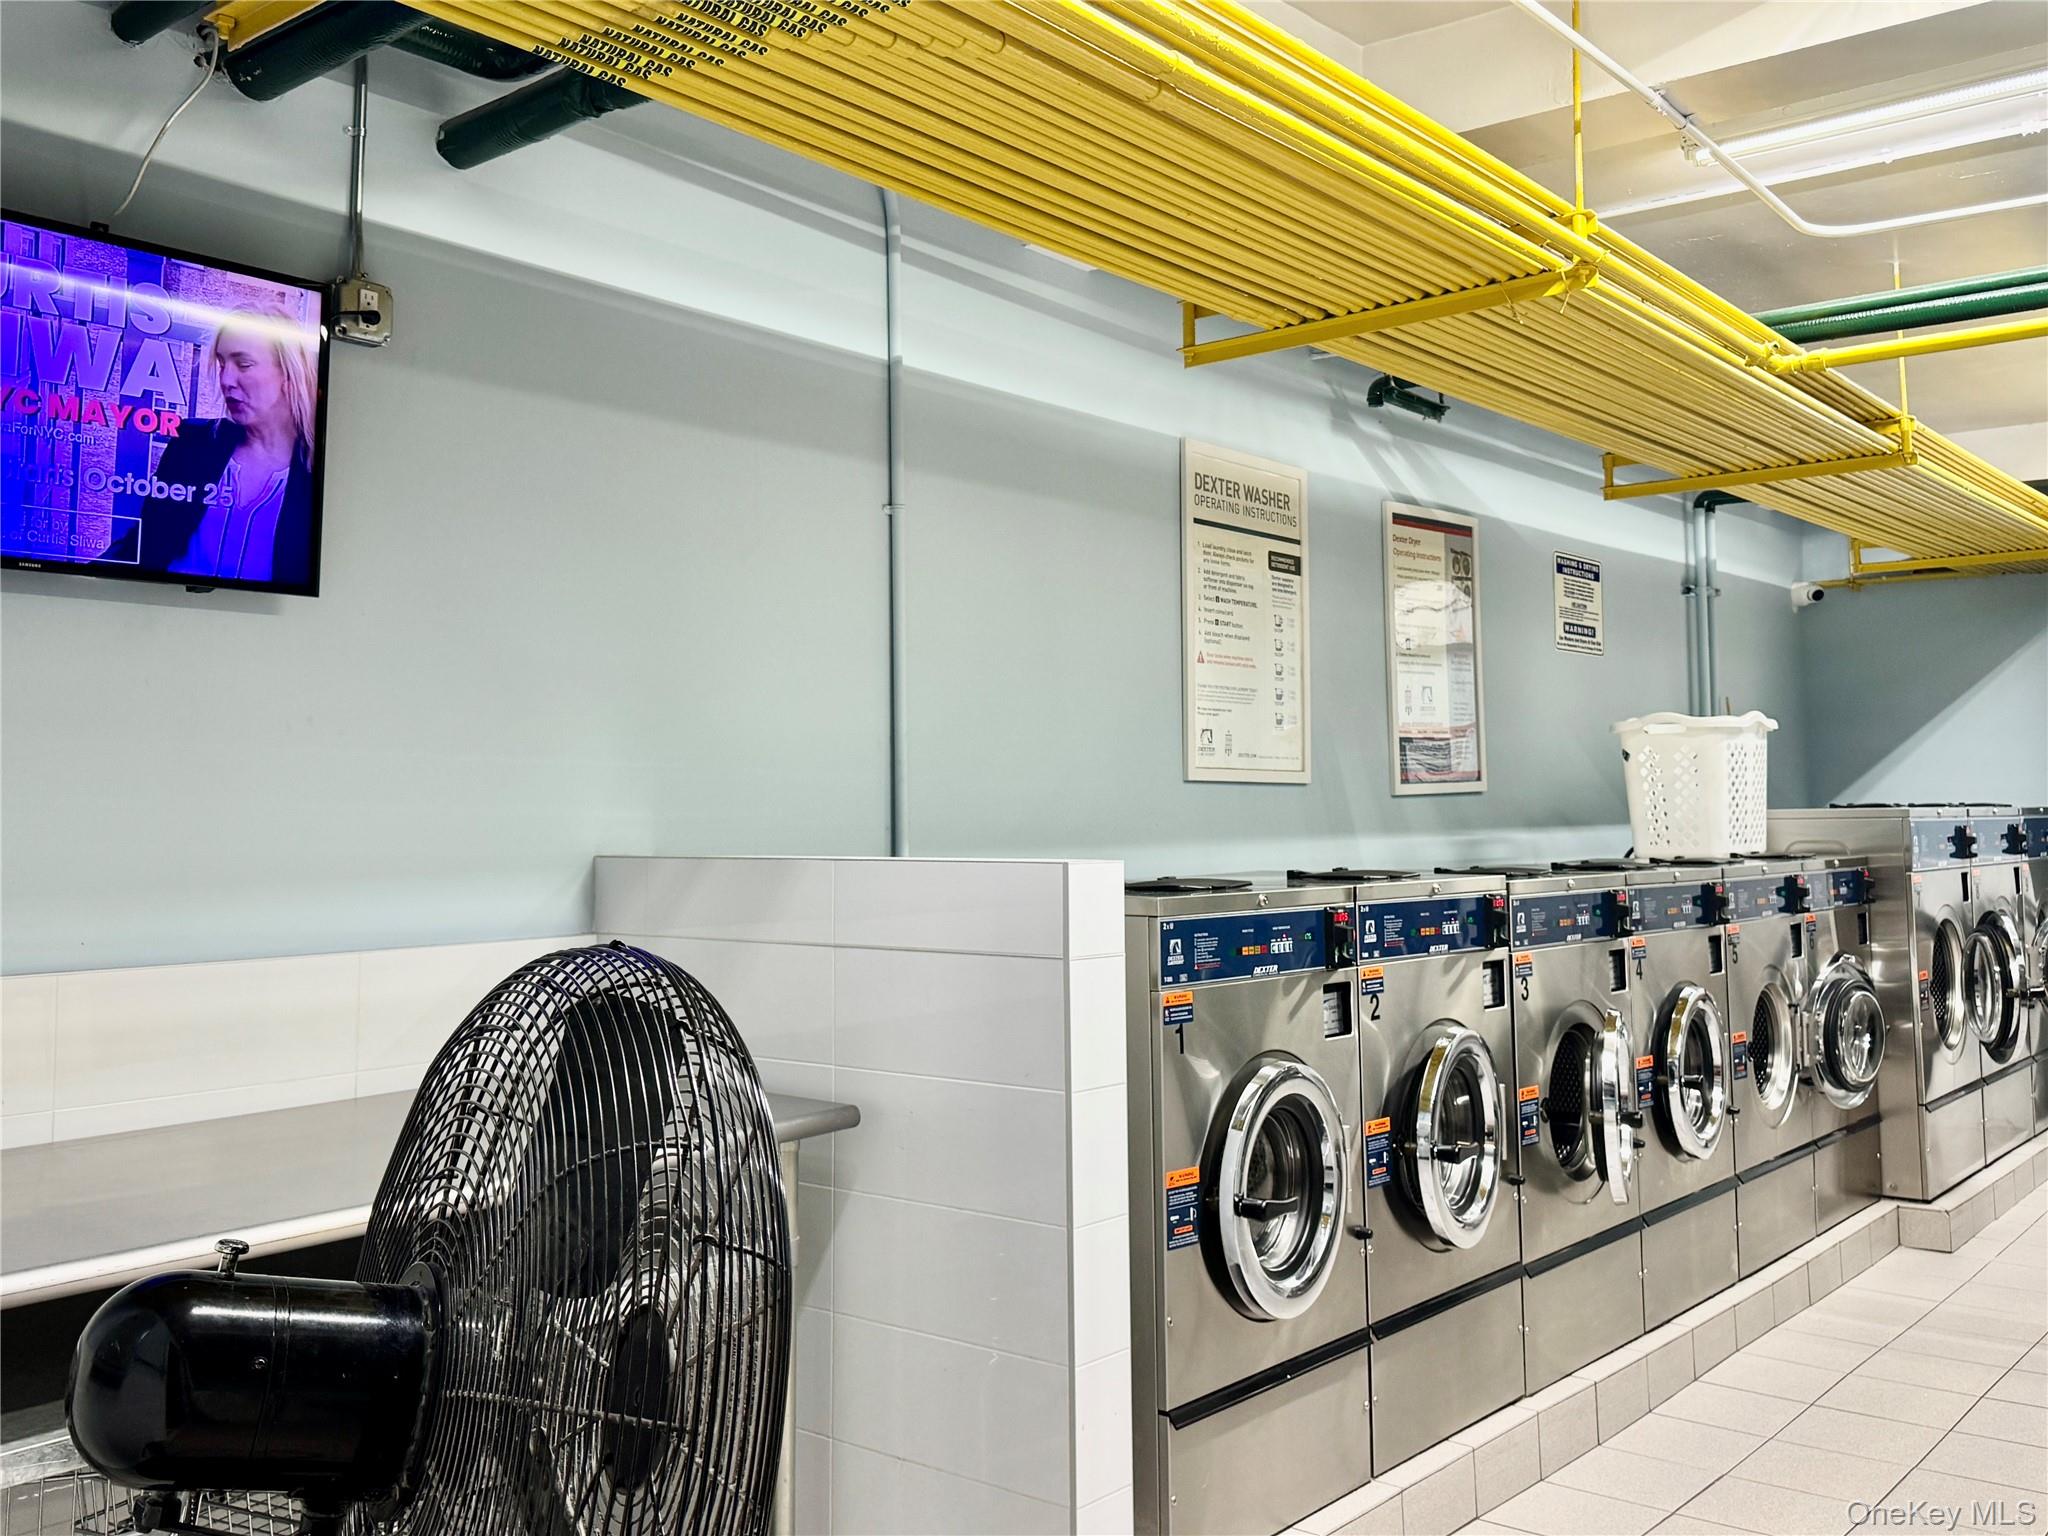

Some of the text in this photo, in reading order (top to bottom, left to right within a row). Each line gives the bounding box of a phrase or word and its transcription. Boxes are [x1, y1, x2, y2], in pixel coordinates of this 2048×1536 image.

[818, 9, 848, 26] GAS
[840, 0, 868, 17] GAS
[654, 15, 747, 58] NATURAL GAS
[675, 12, 769, 56] NATURAL GAS
[737, 17, 768, 36] GAS
[777, 19, 807, 37] GAS
[798, 15, 828, 33] GAS
[579, 33, 673, 78] NATURAL GAS
[601, 26, 696, 69] NATURAL GAS
[632, 24, 725, 67] NATURAL GAS
[532, 45, 627, 87] NATURAL GAS
[557, 37, 652, 80] NATURAL GAS
[0, 252, 172, 335] RTIS
[50, 394, 182, 438] MAYOR
[83, 467, 196, 502] October
[203, 482, 234, 507] 25
[1195, 472, 1290, 511] DEXTER WASHER
[1194, 494, 1297, 527] OPERATING INSTRUCTIONS
[27, 529, 66, 545] Curtis
[70, 534, 105, 549] Sliwa
[1408, 536, 1421, 547] Dryer
[1393, 547, 1416, 560] Operating
[1557, 557, 1578, 568] WASHING
[1583, 563, 1599, 573] DRYING
[1562, 566, 1595, 580] INSTRUCTIONS
[1564, 624, 1595, 637] WARNING!
[1254, 964, 1279, 975] DEXTER
[1636, 960, 1643, 980] 4
[1521, 977, 1529, 1000] 3
[1370, 994, 1381, 1021] 2
[1175, 1024, 1184, 1054] 1
